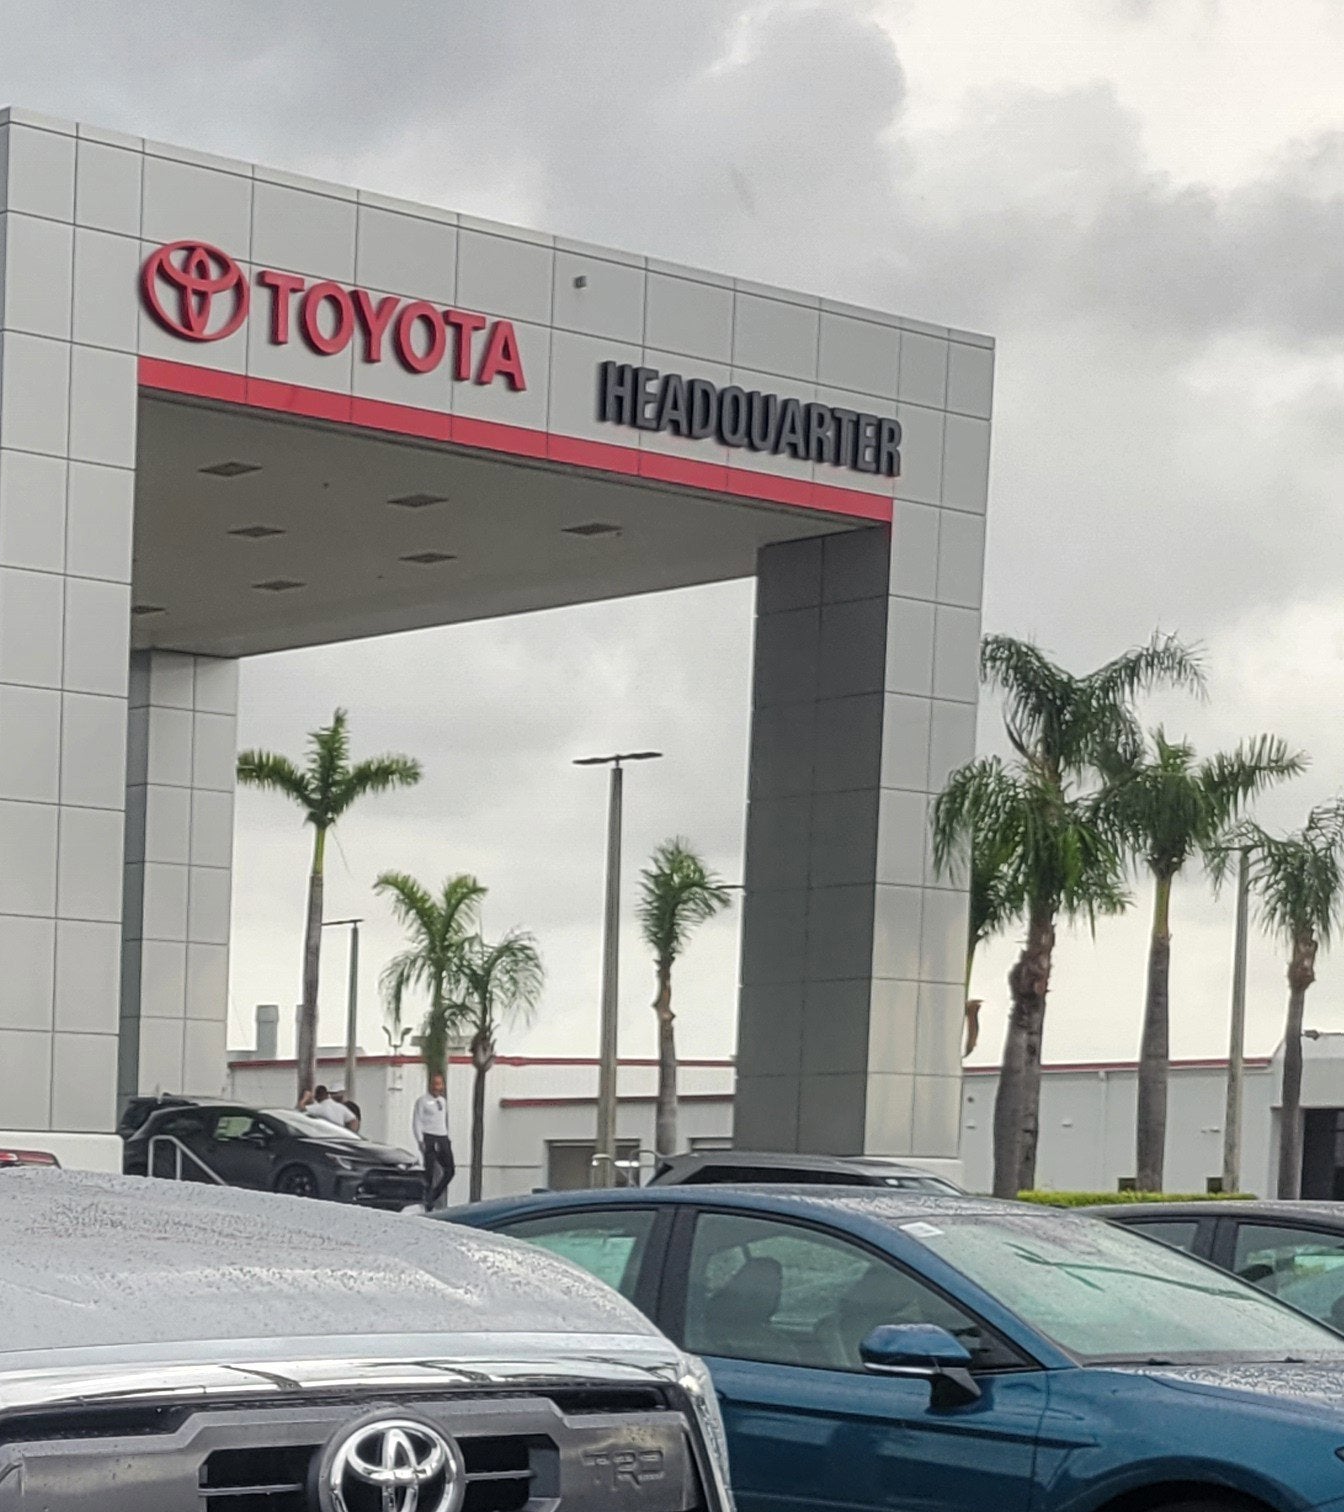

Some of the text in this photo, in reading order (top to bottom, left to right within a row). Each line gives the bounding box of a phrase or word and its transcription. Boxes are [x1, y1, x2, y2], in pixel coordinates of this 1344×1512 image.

[257, 269, 903, 477] TOYOTA HEADQUARTER
[579, 1446, 664, 1489] TRD
